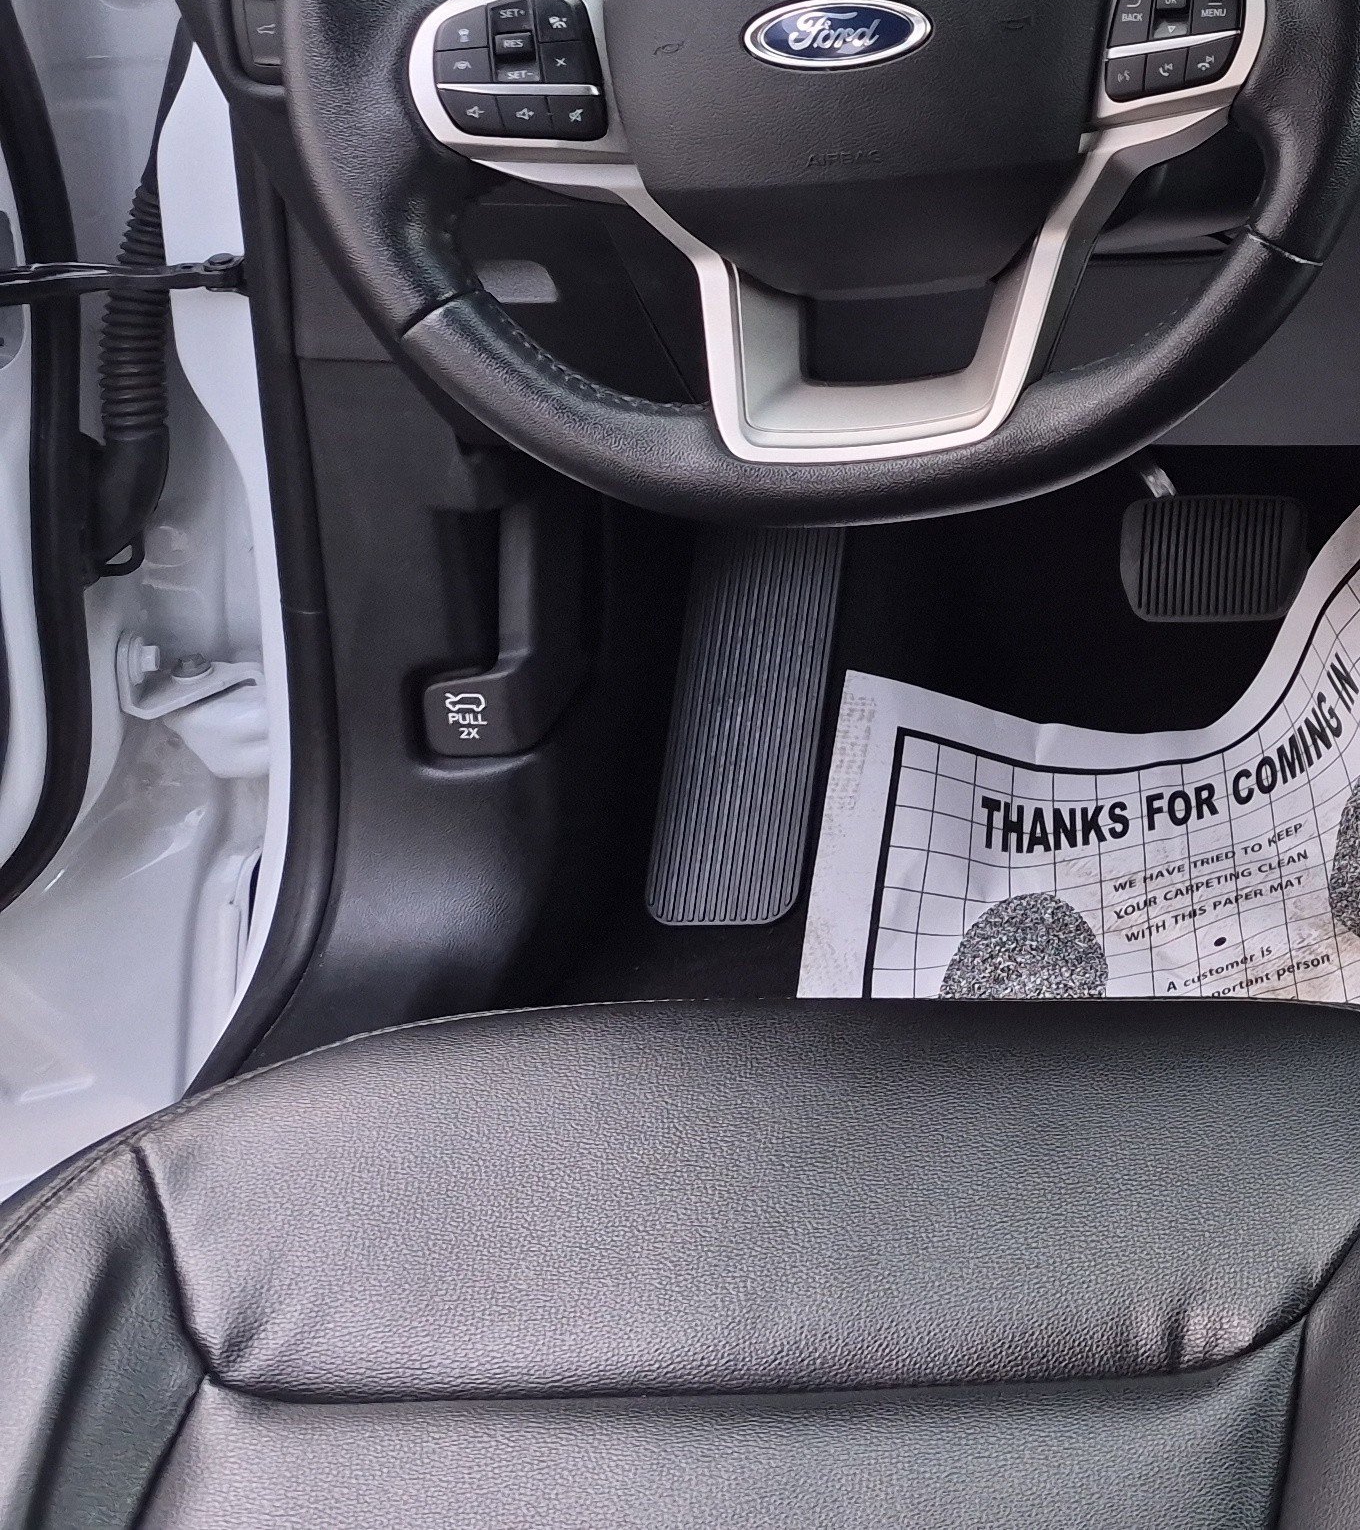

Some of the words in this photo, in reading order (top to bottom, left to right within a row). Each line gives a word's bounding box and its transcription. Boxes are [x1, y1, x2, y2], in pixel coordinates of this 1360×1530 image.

[1122, 13, 1143, 22] BACK
[1201, 8, 1227, 18] MENU
[503, 39, 524, 49] RES
[788, 11, 882, 51] Ford
[448, 712, 488, 725] PULL
[458, 727, 480, 739] 2X
[981, 795, 1130, 854] THANKS
[1145, 782, 1220, 832] FOR
[1232, 691, 1343, 805] COMING
[1327, 651, 1360, 714] IN
[1113, 878, 1137, 893] WE
[1143, 864, 1186, 883] HAVE
[1190, 850, 1236, 869] TRIED
[1241, 842, 1262, 856] TO
[1267, 822, 1303, 848] KEEP
[1113, 895, 1157, 920] YOUR
[1163, 867, 1252, 902] CARPETING
[1257, 849, 1309, 873] CLEAN
[1125, 919, 1167, 943] WITH
[1171, 905, 1207, 925] THIS
[1212, 888, 1264, 911] PAPER
[1269, 875, 1304, 893] MAT
[1166, 980, 1178, 993] A
[1183, 953, 1255, 987] customer
[1260, 945, 1273, 958] is
[1276, 953, 1331, 981] person
